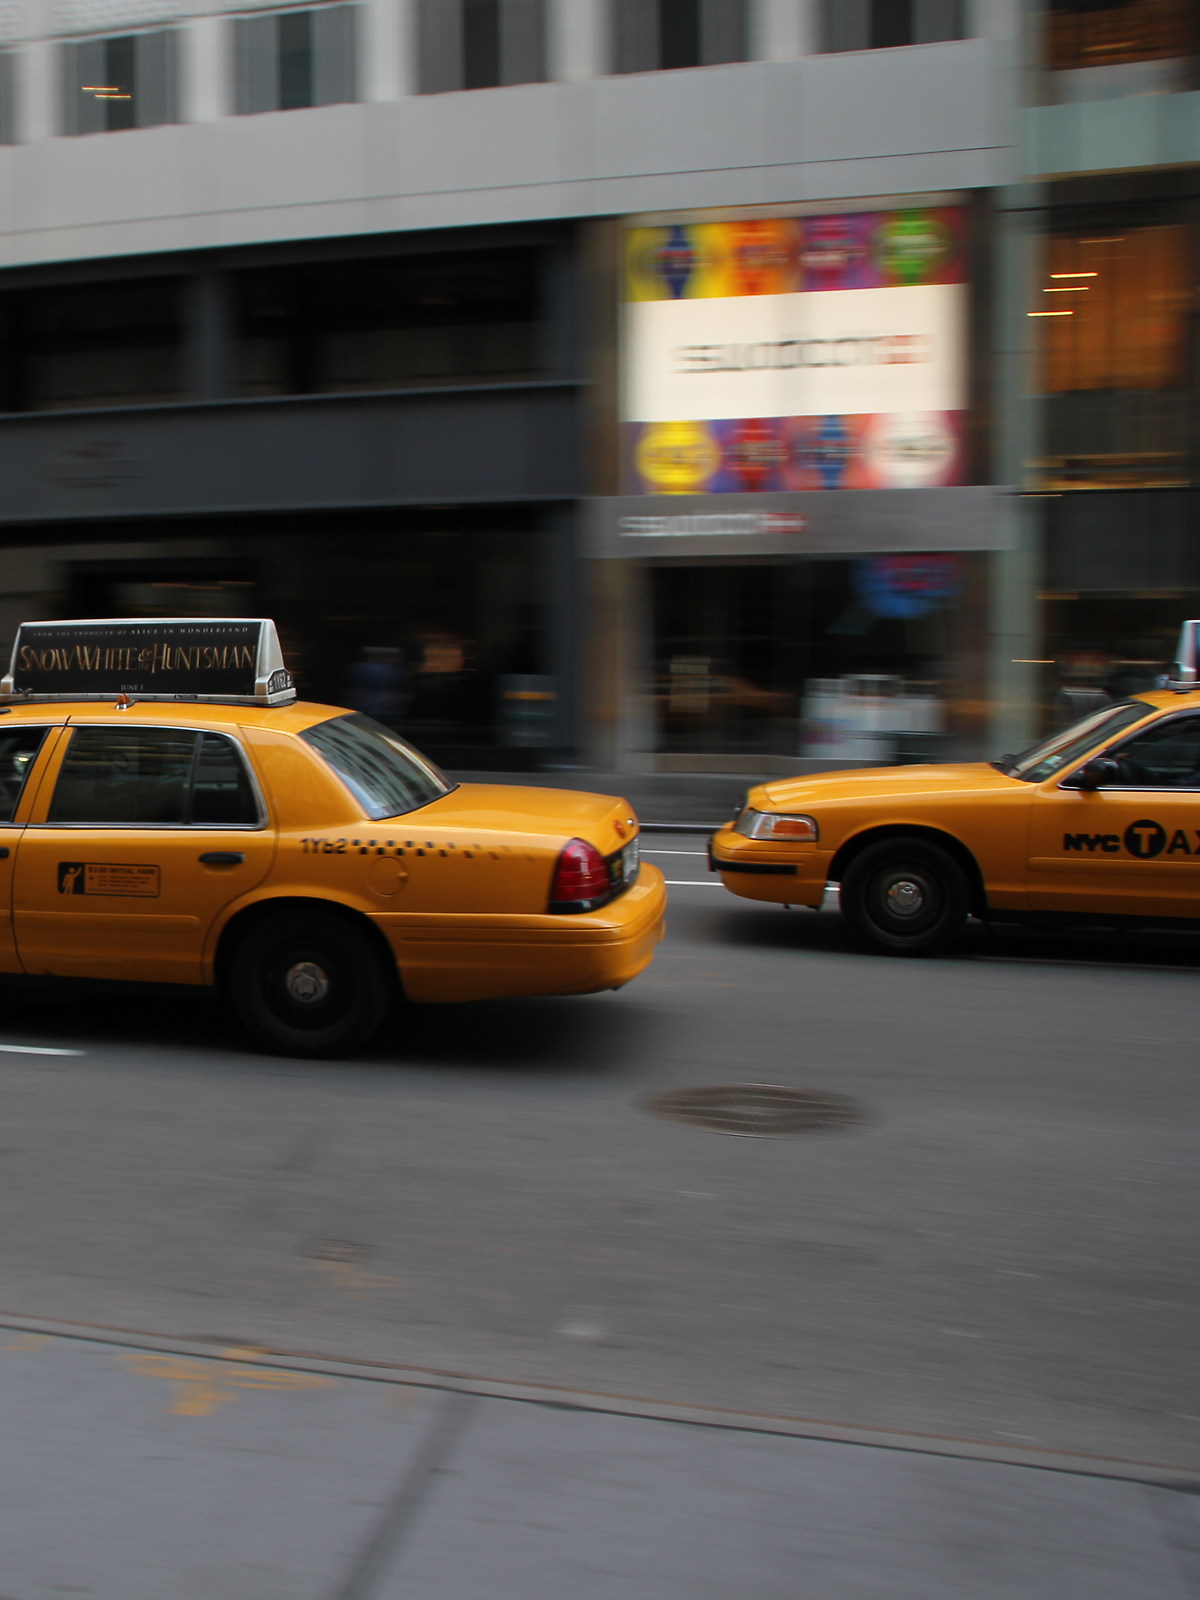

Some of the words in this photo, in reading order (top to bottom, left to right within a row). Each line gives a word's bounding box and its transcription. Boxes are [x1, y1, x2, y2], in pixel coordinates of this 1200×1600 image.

[18, 645, 75, 671] SNOW
[75, 644, 137, 671] WHITE
[151, 643, 256, 673] HUNTSMAN
[1063, 833, 1120, 852] NYC
[1129, 823, 1200, 856] TA
